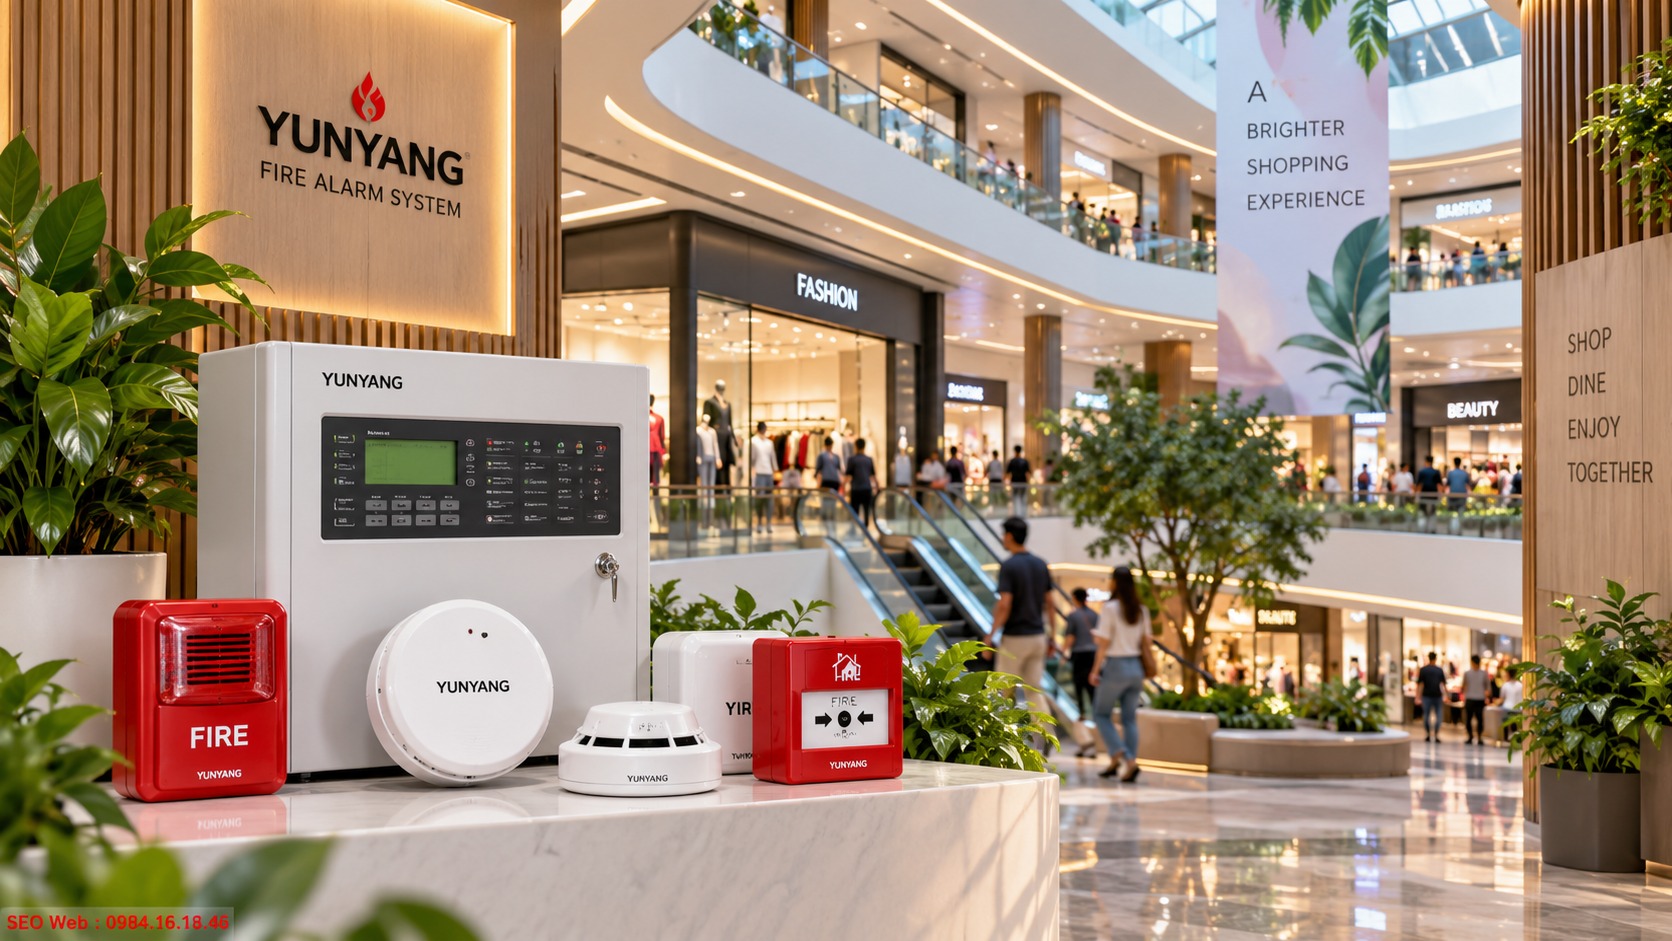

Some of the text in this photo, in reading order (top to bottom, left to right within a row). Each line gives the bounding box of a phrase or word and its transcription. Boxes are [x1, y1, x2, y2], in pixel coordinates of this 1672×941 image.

[1247, 80, 1267, 103] A
[1247, 119, 1345, 139] BRIGHTER
[257, 105, 464, 186] YUNYANG
[1247, 154, 1349, 175] SHOPPING
[260, 160, 461, 218] FIRE ALARM SYSTEM
[1247, 189, 1365, 211] EXPERIENCE
[797, 272, 858, 311] FASHION
[1568, 326, 1612, 354] SHOP
[322, 371, 403, 390] YUNYANG
[1568, 371, 1606, 397] DINE
[1447, 400, 1499, 419] BEAUTY
[1568, 415, 1621, 440] ENJOY
[1567, 461, 1653, 483] TOGETHER
[436, 679, 511, 694] YUNYANG
[831, 696, 858, 708] FIRE
[190, 724, 249, 749] FIRE
[197, 769, 242, 780] YUNYANG
[829, 759, 868, 770] YUNYANG
[627, 774, 669, 783] YUNYANG
